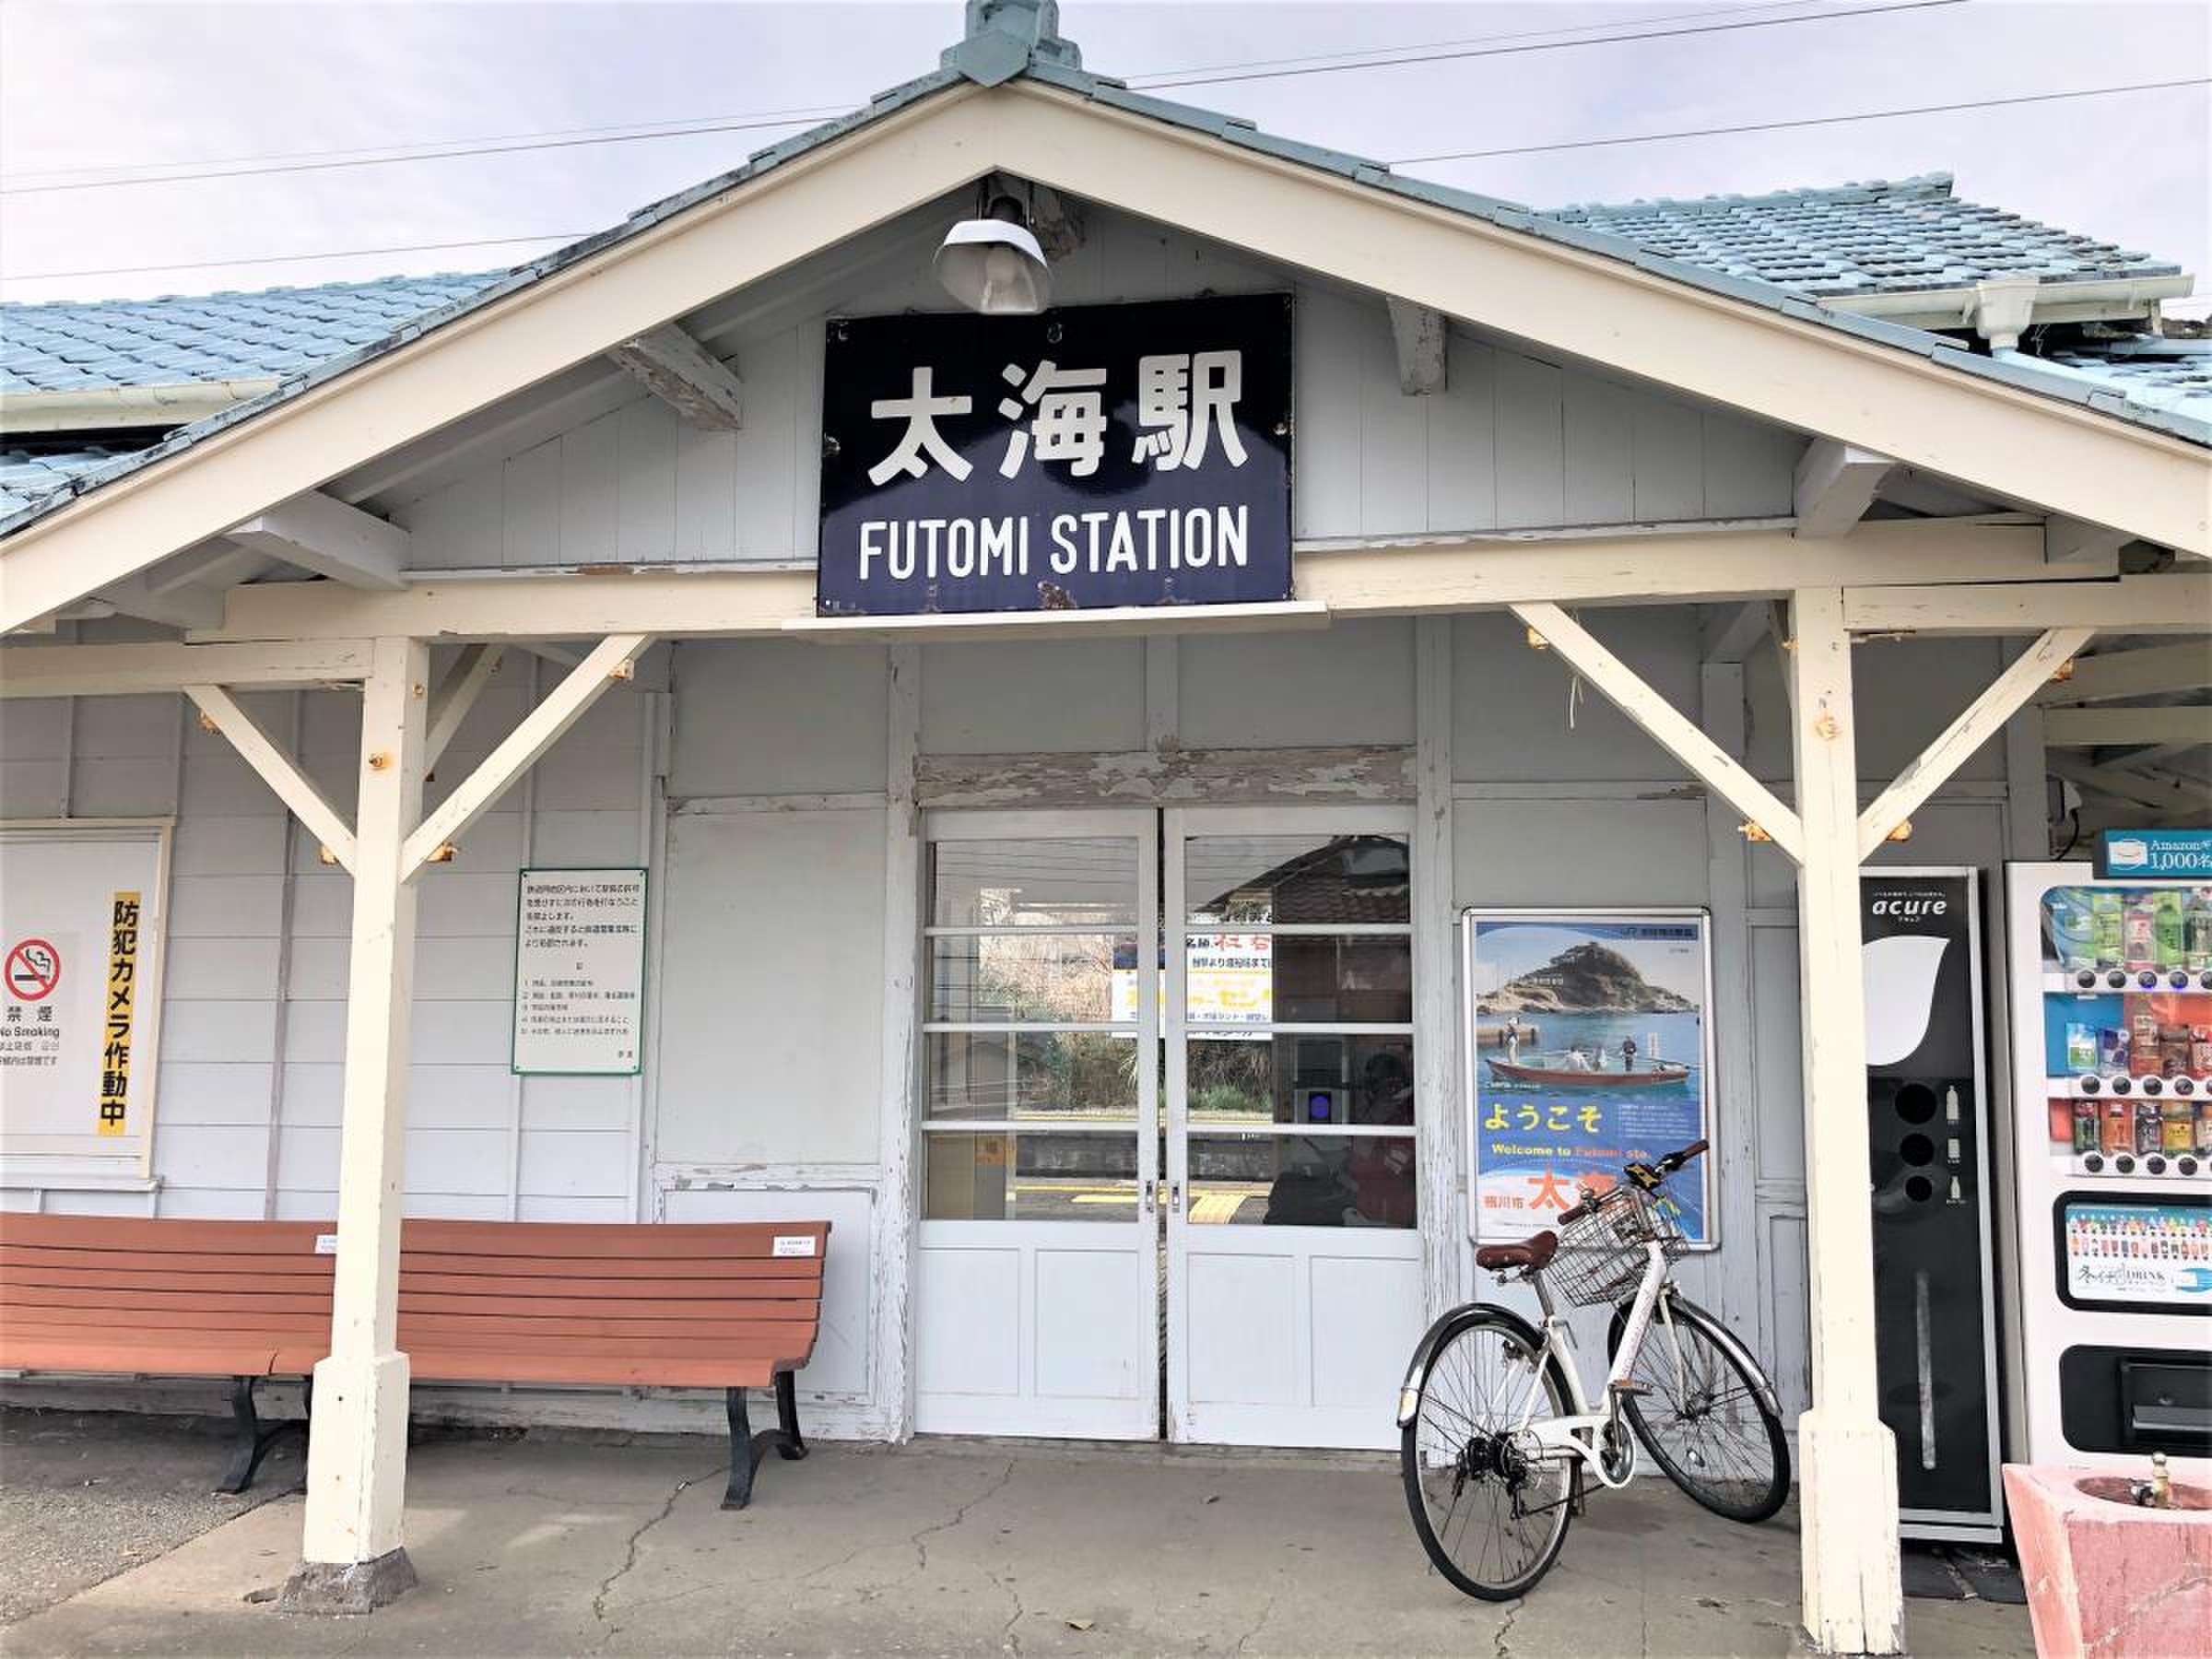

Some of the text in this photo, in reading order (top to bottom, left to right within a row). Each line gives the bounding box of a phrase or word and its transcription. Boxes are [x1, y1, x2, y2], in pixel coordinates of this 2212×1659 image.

[867, 350, 1248, 487] 太海駅
[859, 506, 1248, 581] FUTOMI STATION
[1872, 900, 1947, 915] acure
[7, 1006, 53, 1022] 禁煙
[100, 900, 140, 1126] 防犯カメラ作動中
[14, 1026, 60, 1040] Smoking
[1484, 1103, 1603, 1134] ようこそ
[1491, 1143, 1553, 1157] Welcome
[1558, 1146, 1571, 1158] to
[1483, 1195, 1524, 1209] 鴨川市
